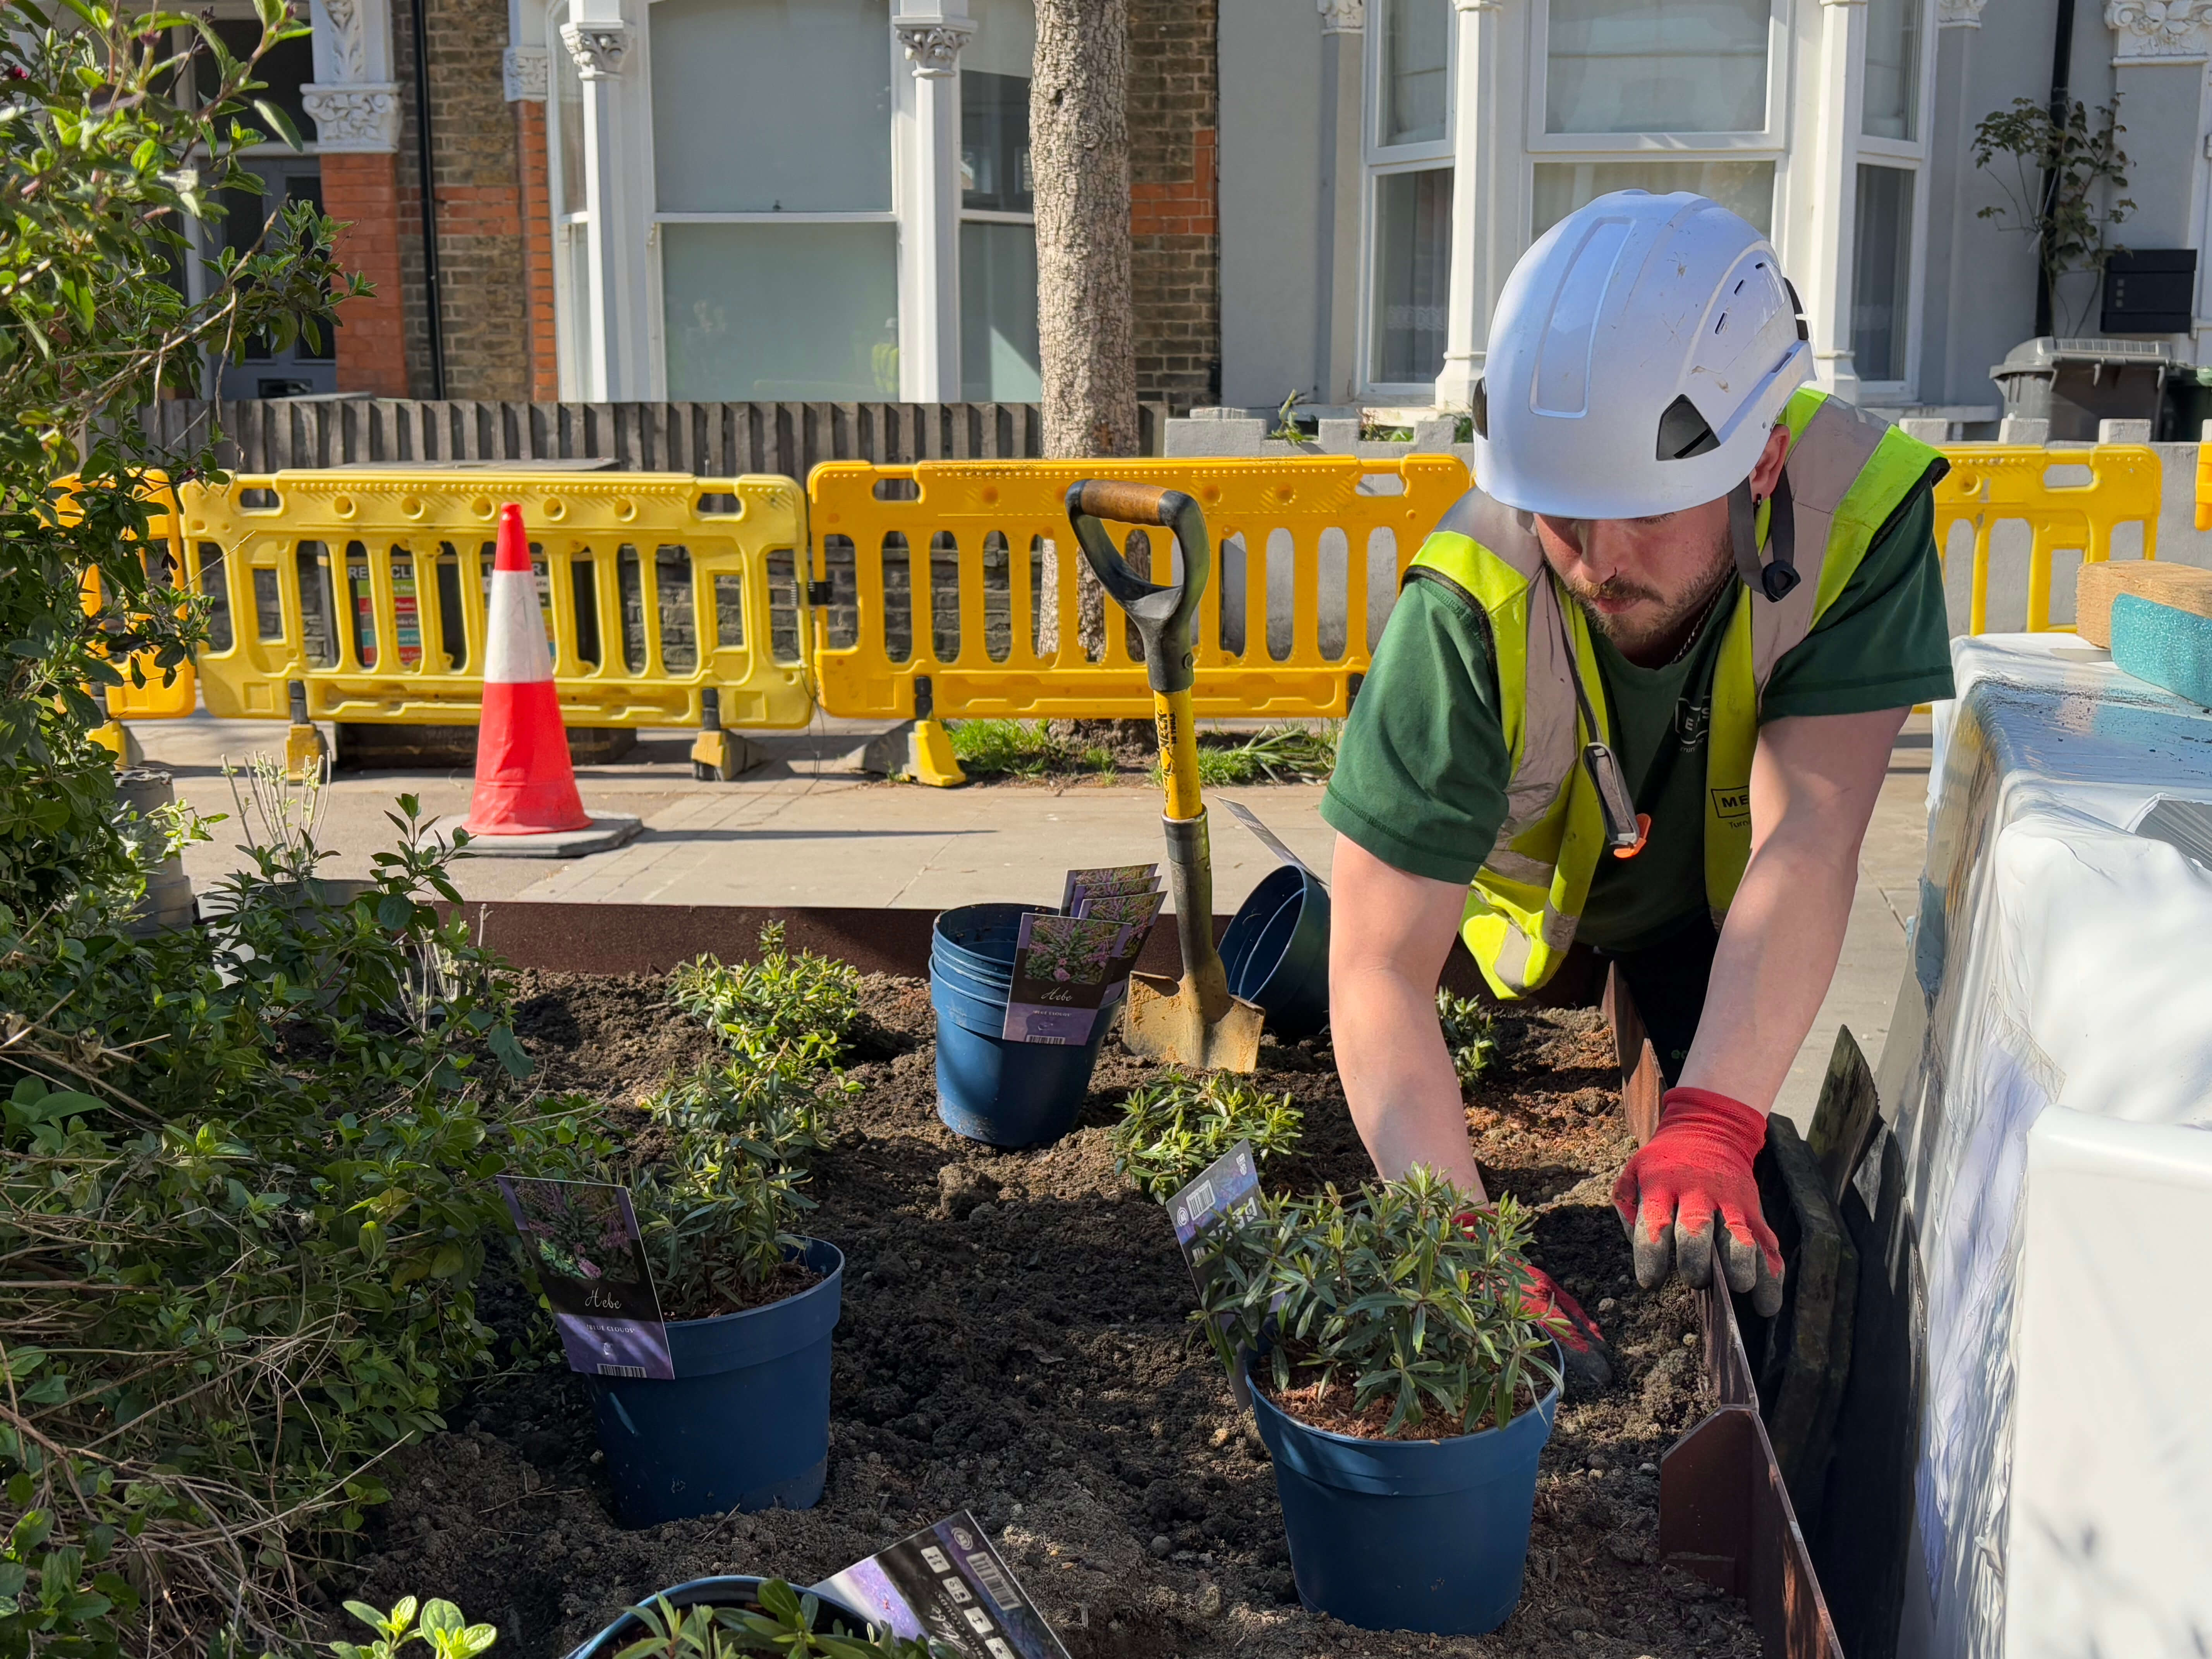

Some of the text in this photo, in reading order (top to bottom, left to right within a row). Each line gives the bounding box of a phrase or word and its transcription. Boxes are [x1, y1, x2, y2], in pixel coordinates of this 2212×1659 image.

[1721, 794, 1749, 808] ME
[1728, 821, 1750, 829] Turn
[1041, 987, 1072, 1001] Hebe
[584, 1287, 622, 1310] Hebe
[929, 1604, 969, 1651] Hebe
